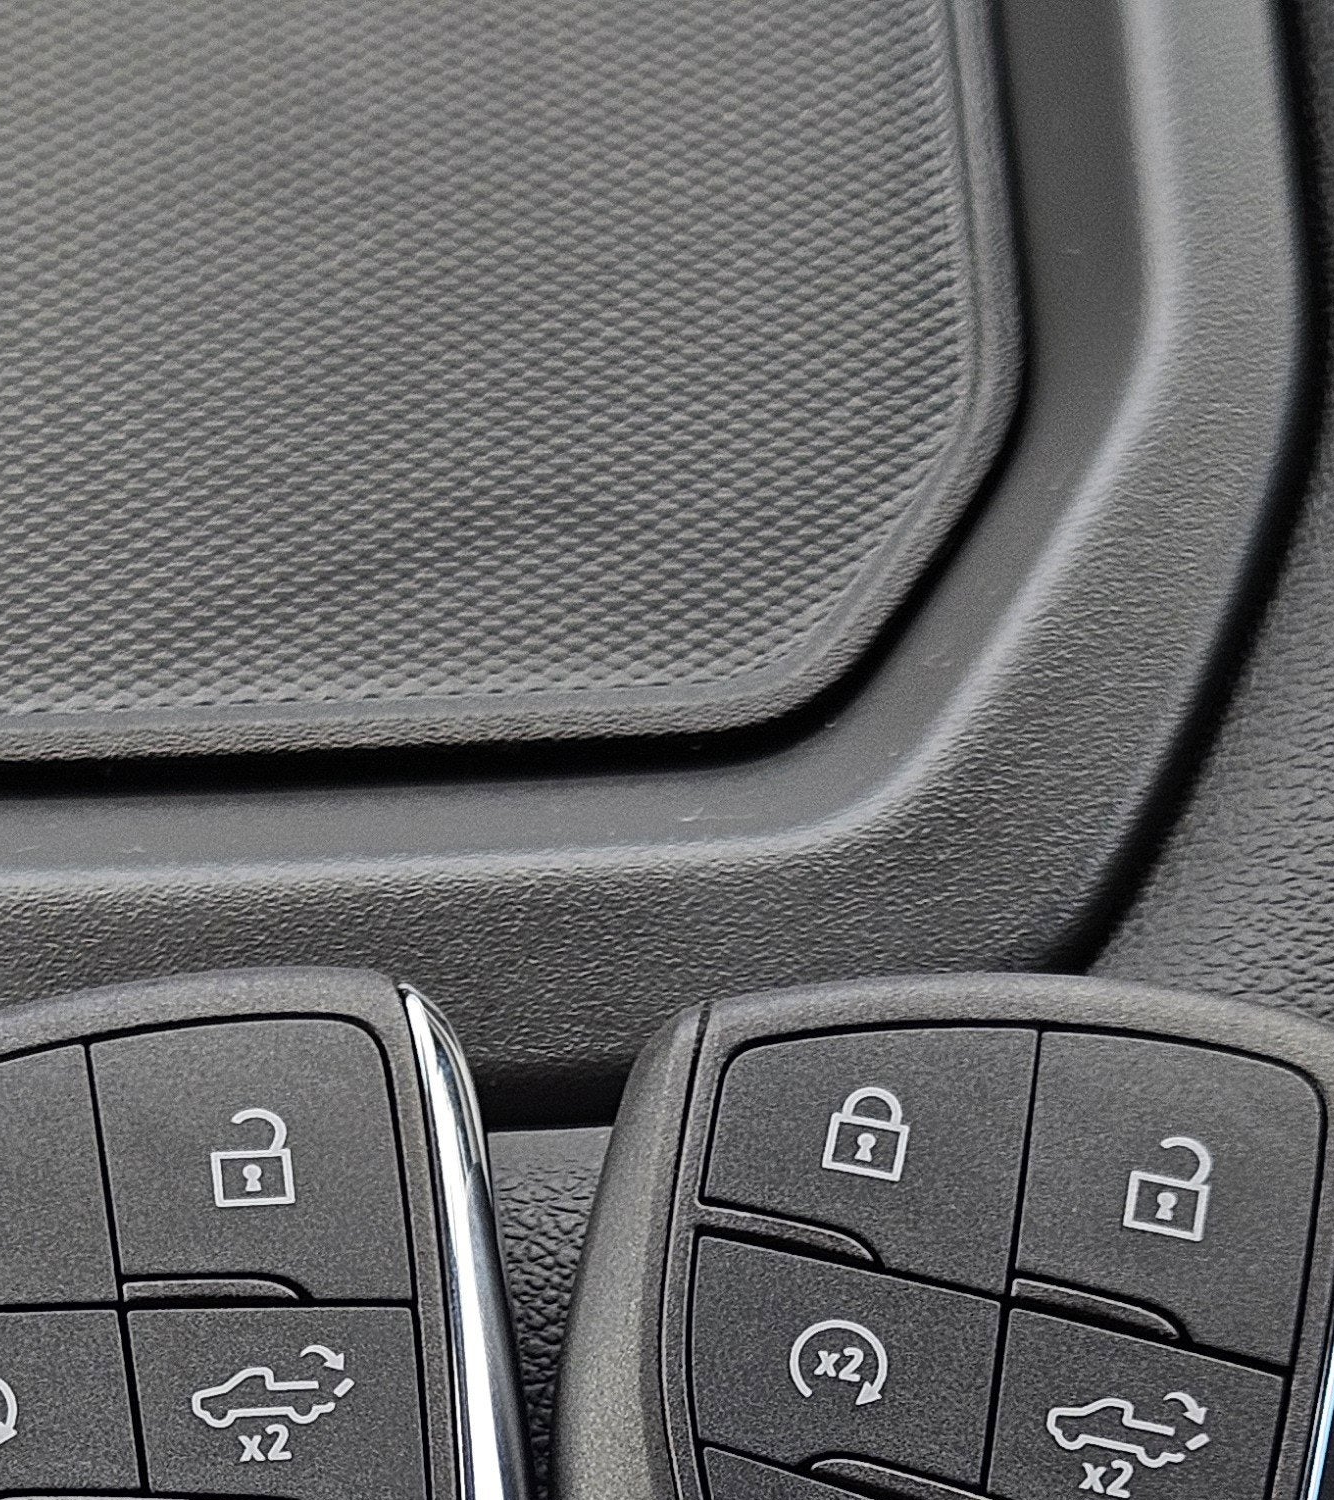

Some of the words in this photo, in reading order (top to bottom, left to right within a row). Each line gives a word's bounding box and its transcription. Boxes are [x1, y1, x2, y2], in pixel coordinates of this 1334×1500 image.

[814, 1346, 865, 1382] x2
[238, 1424, 293, 1462] x2
[1079, 1460, 1134, 1499] x2
